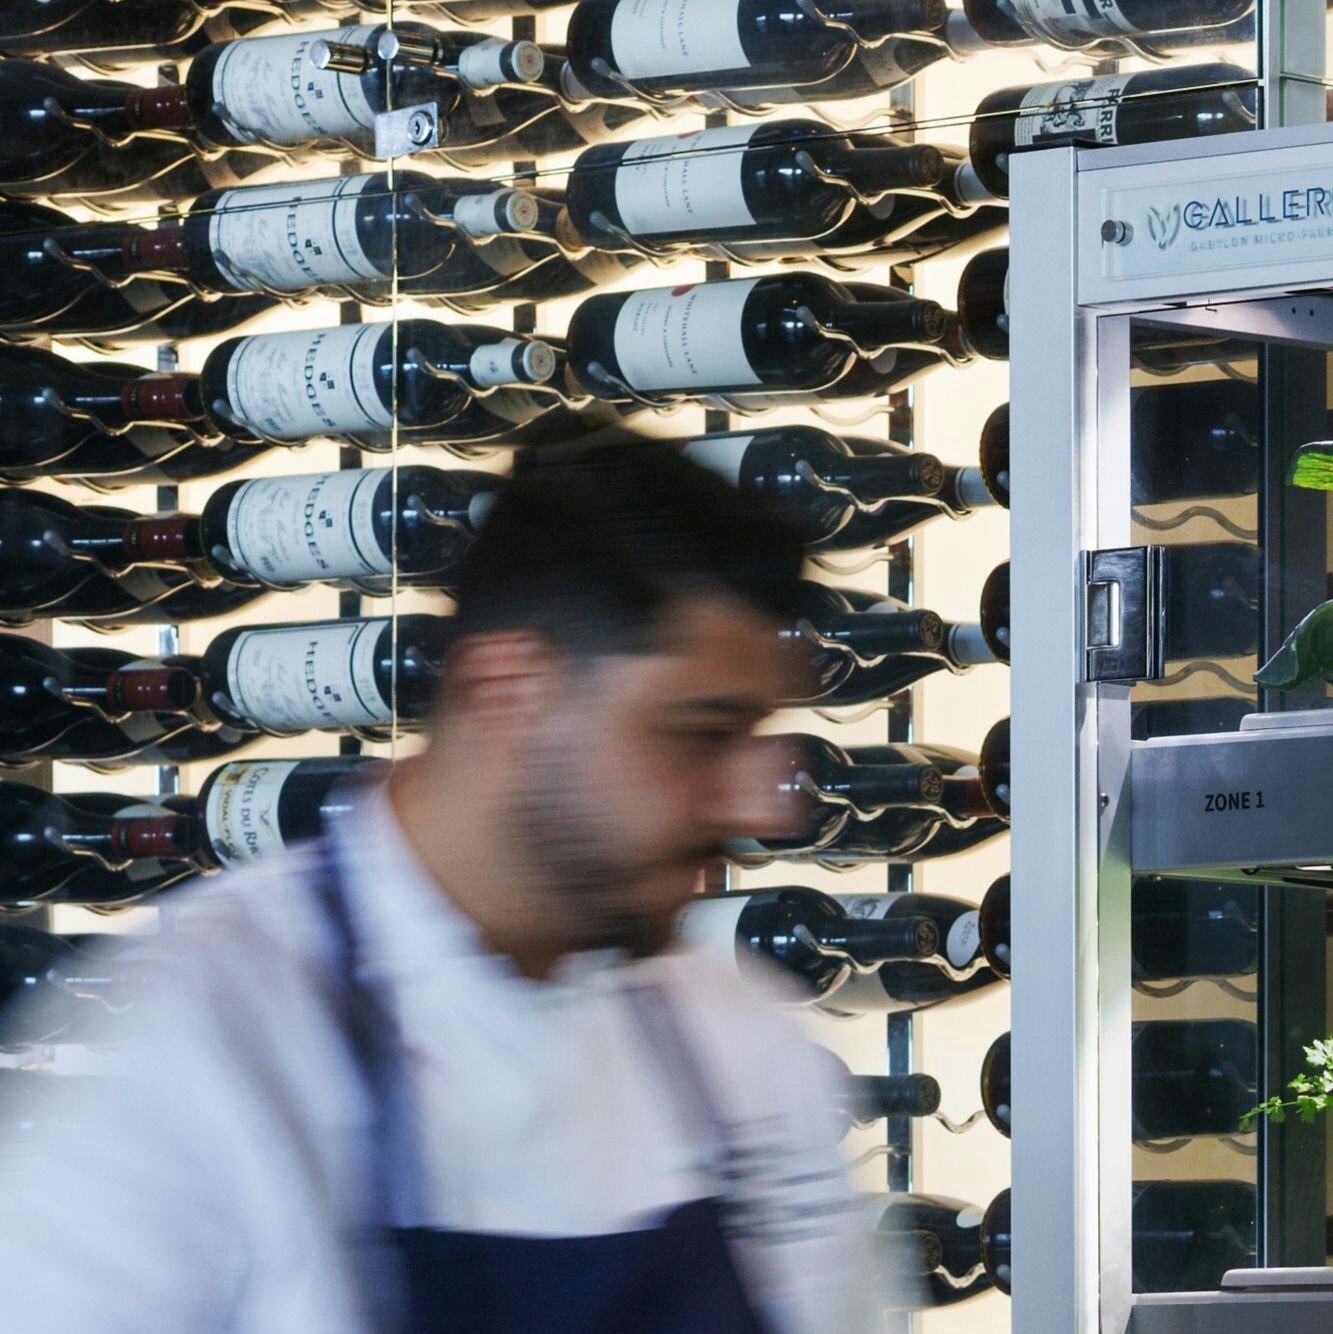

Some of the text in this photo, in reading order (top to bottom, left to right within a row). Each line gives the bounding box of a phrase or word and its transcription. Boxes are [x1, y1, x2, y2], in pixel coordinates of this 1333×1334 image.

[680, 294, 699, 375] WHITEHALL LANE
[1204, 790, 1265, 812] ZONE 1
[241, 807, 252, 828] DU
